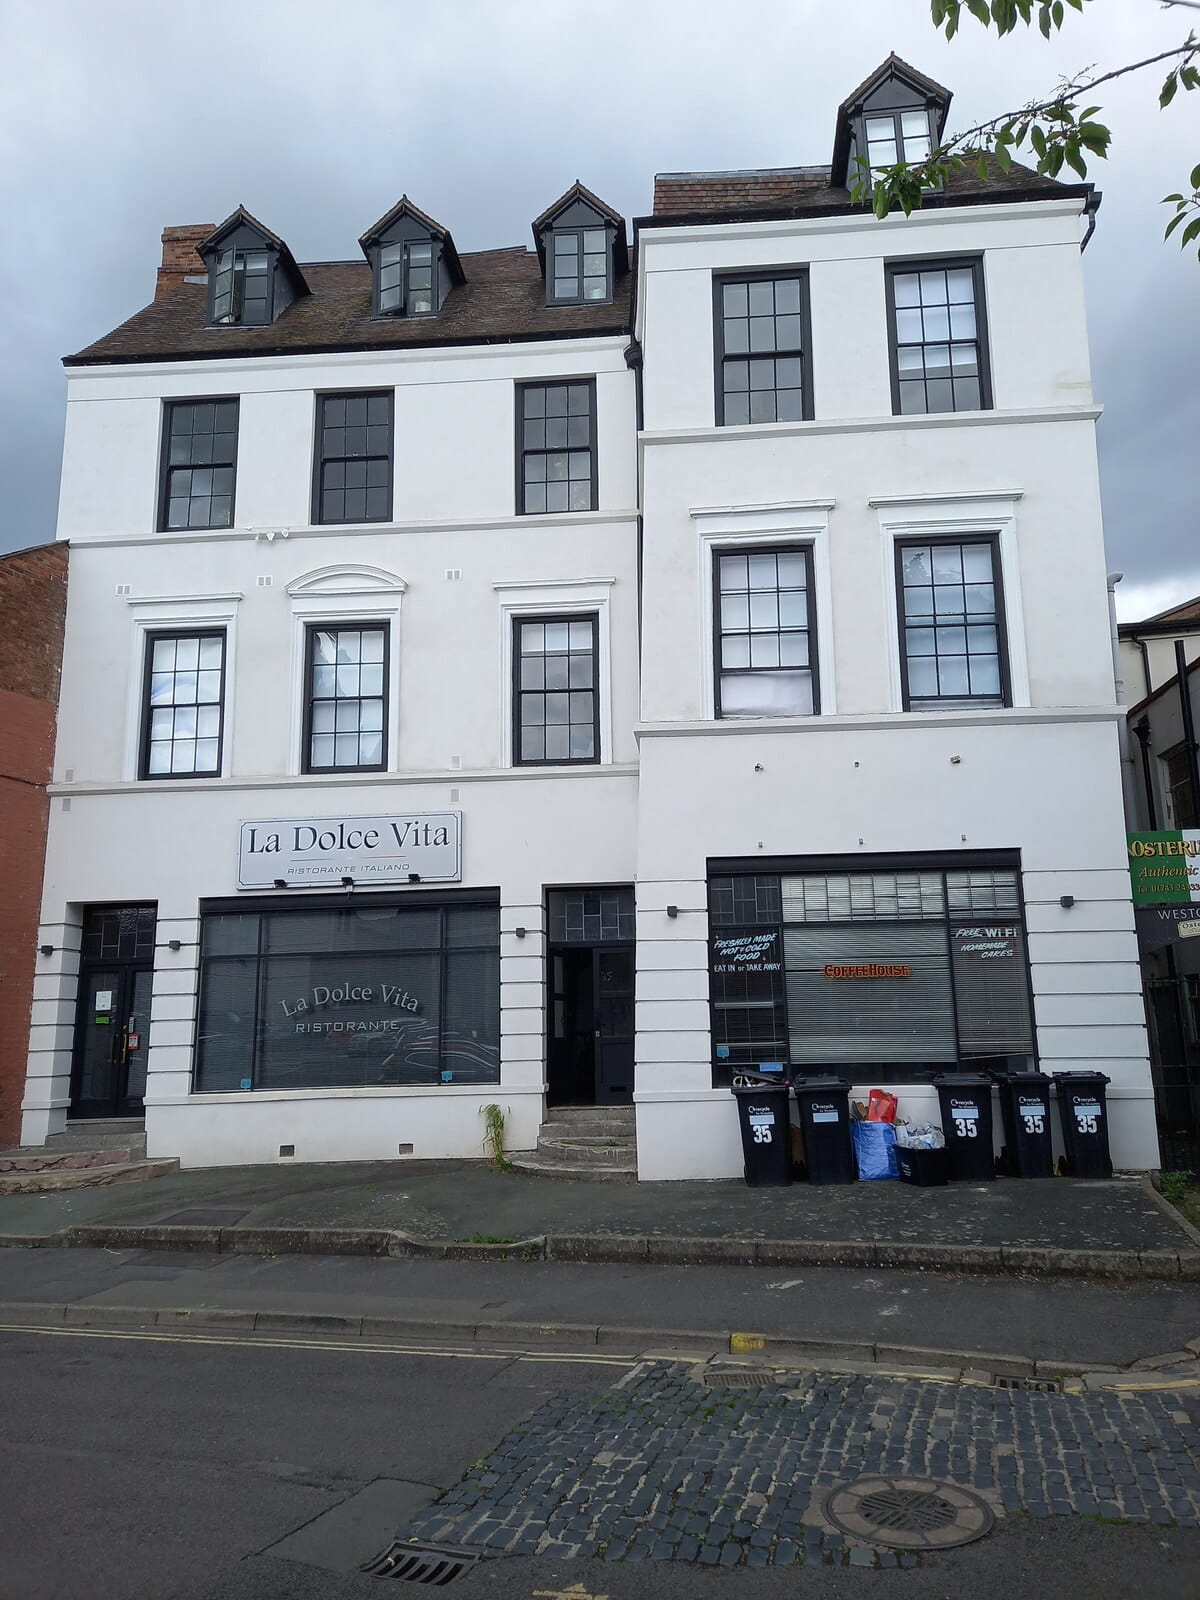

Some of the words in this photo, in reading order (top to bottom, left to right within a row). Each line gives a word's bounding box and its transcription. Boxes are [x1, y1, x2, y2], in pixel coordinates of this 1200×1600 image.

[247, 828, 281, 854] La
[292, 822, 379, 851] Dolce
[390, 820, 450, 847] Vita
[1132, 840, 1200, 857] OSTERI
[287, 865, 356, 874] RISTORANTE
[360, 863, 410, 872] ITALIANO
[1138, 865, 1199, 878] Authentic
[752, 933, 778, 944] MADE
[955, 928, 982, 938] FREE
[720, 947, 741, 956] HOT
[745, 943, 770, 952] COLD
[960, 941, 1009, 952] HOMEMADE
[734, 952, 761, 961] FOOD
[981, 949, 1014, 959] CAKES
[714, 964, 727, 973] EAT
[728, 964, 736, 972] IN
[746, 963, 762, 971] TAKE
[763, 962, 781, 971] AWAY
[280, 996, 308, 1017] La
[312, 982, 372, 1006] Dolce
[380, 983, 419, 1013] Vita
[295, 1020, 400, 1033] RISTORANTE
[955, 1118, 978, 1138] 35
[1024, 1115, 1044, 1134] 35
[1077, 1115, 1098, 1134] 35
[752, 1124, 772, 1143] 35
